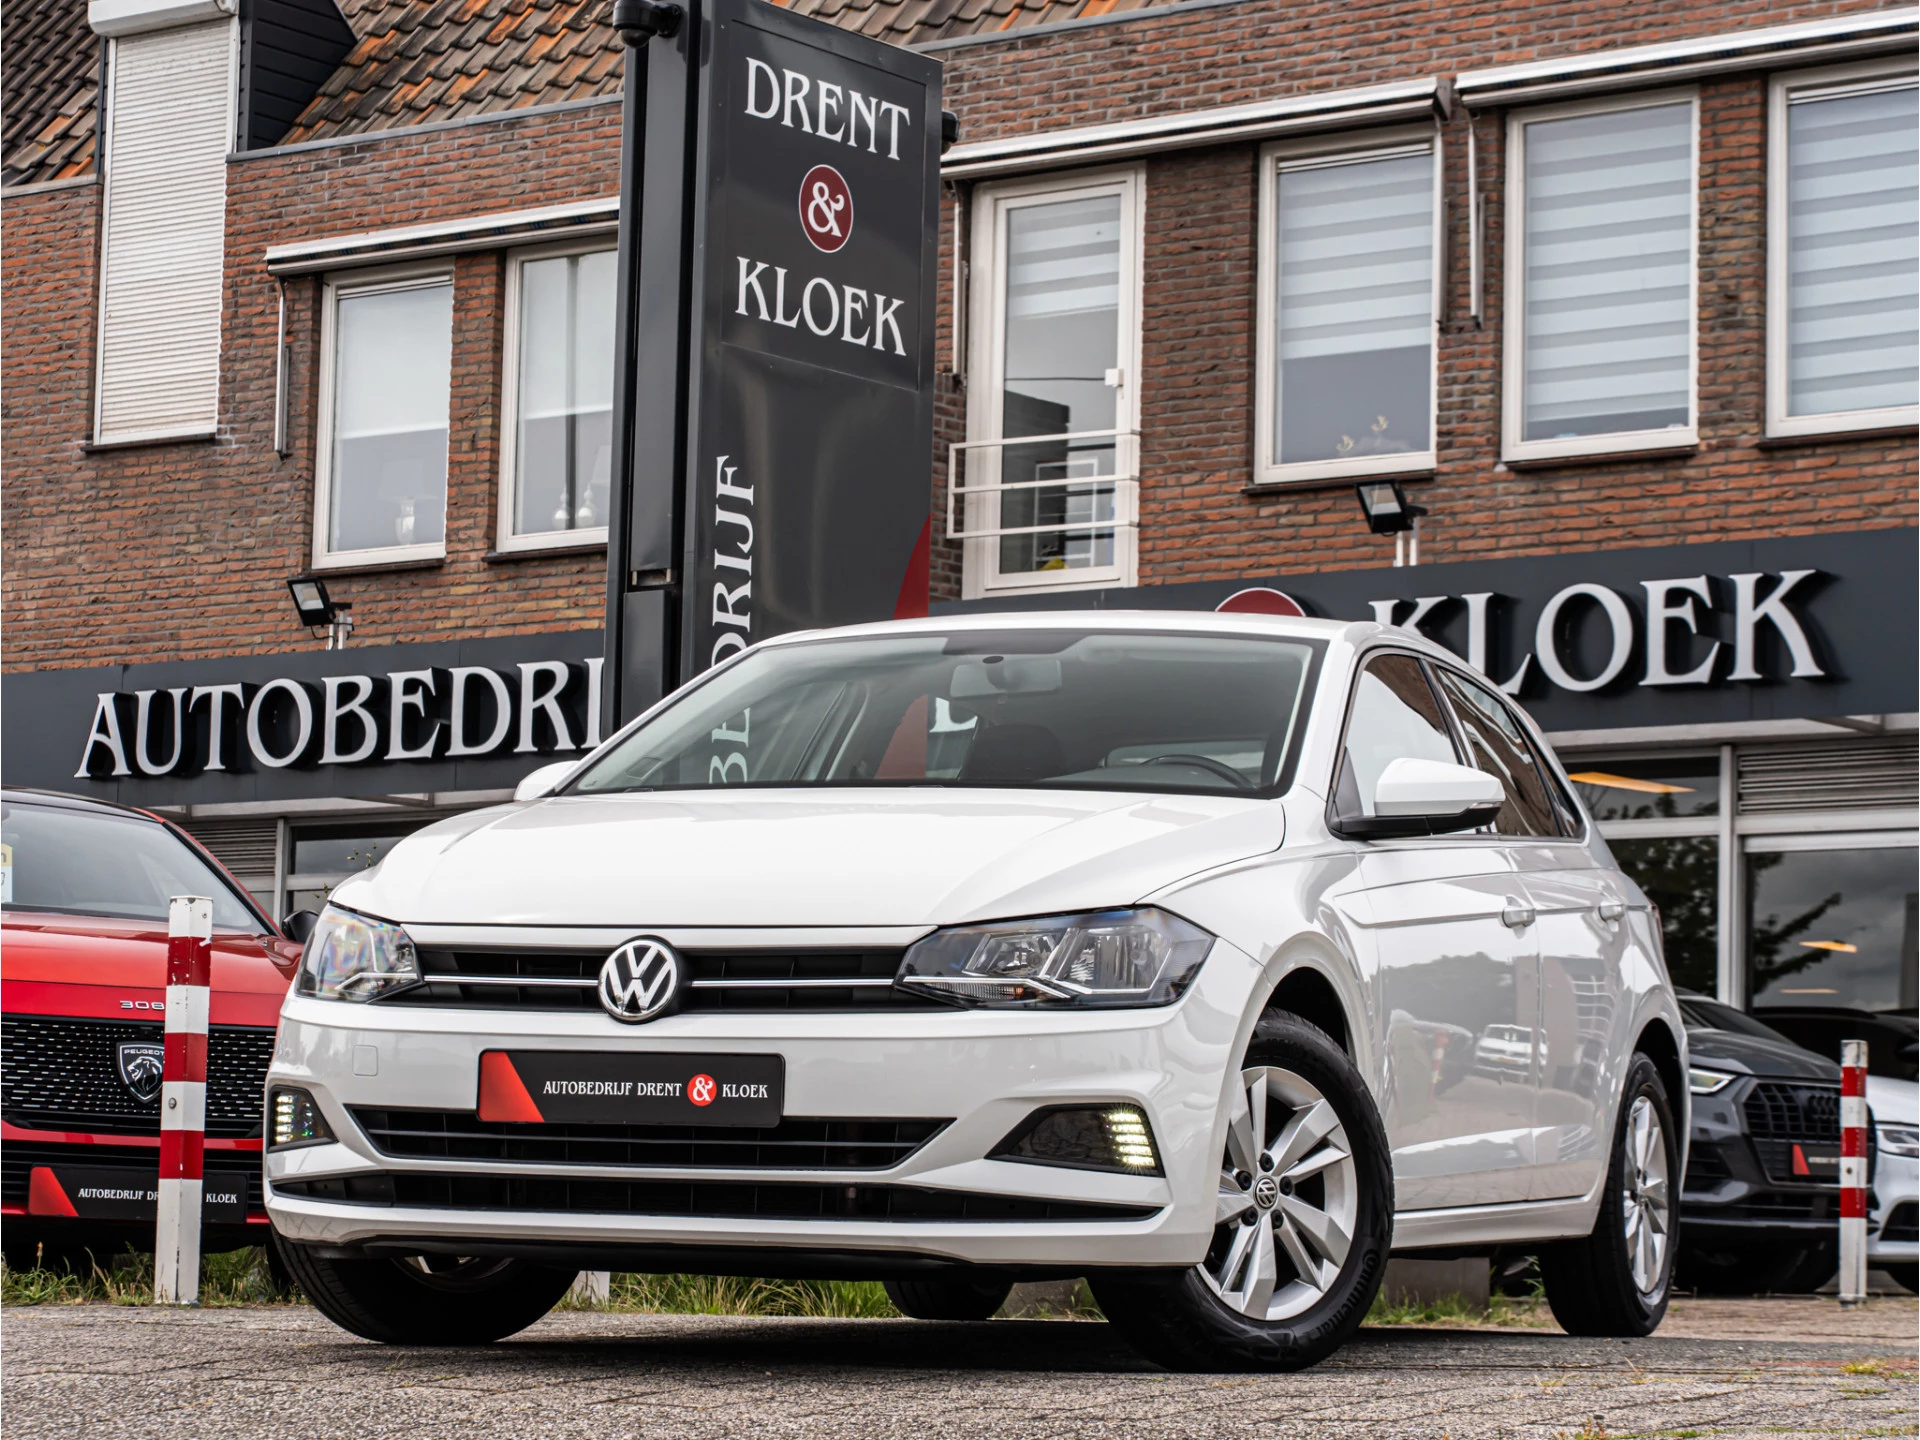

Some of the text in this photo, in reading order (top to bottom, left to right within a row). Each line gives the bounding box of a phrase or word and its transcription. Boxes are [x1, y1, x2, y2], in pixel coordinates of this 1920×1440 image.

[744, 57, 910, 161] DRENT
[807, 181, 844, 238] &
[735, 256, 907, 356] KLOEK
[542, 1077, 768, 1101] AUTOBEDRIJF DRENT & KLOEK
[78, 1188, 144, 1200] AUTOBEDRIJF
[206, 1193, 237, 1203] KLOEK
